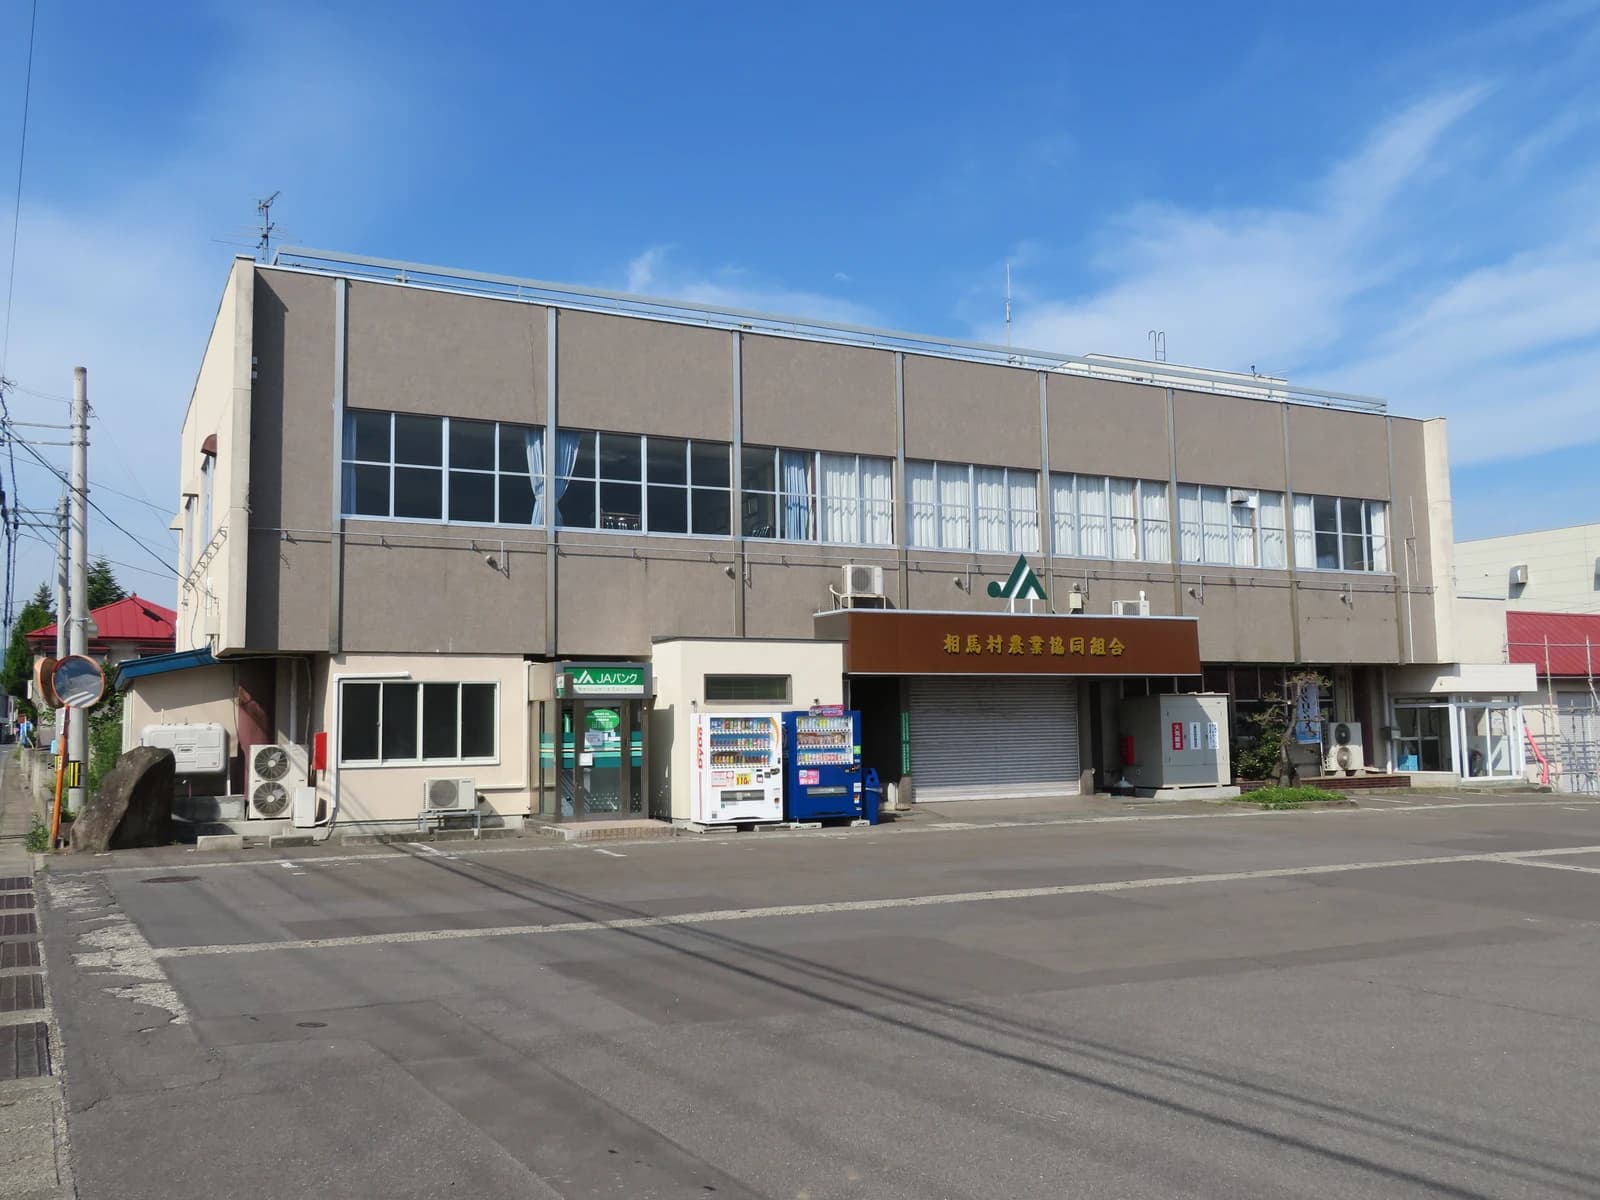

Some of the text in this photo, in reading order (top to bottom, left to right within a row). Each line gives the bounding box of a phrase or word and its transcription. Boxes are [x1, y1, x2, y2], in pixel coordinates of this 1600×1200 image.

[943, 633, 1126, 656] 相馬村農業協同組合
[596, 673, 638, 684] JAバンク
